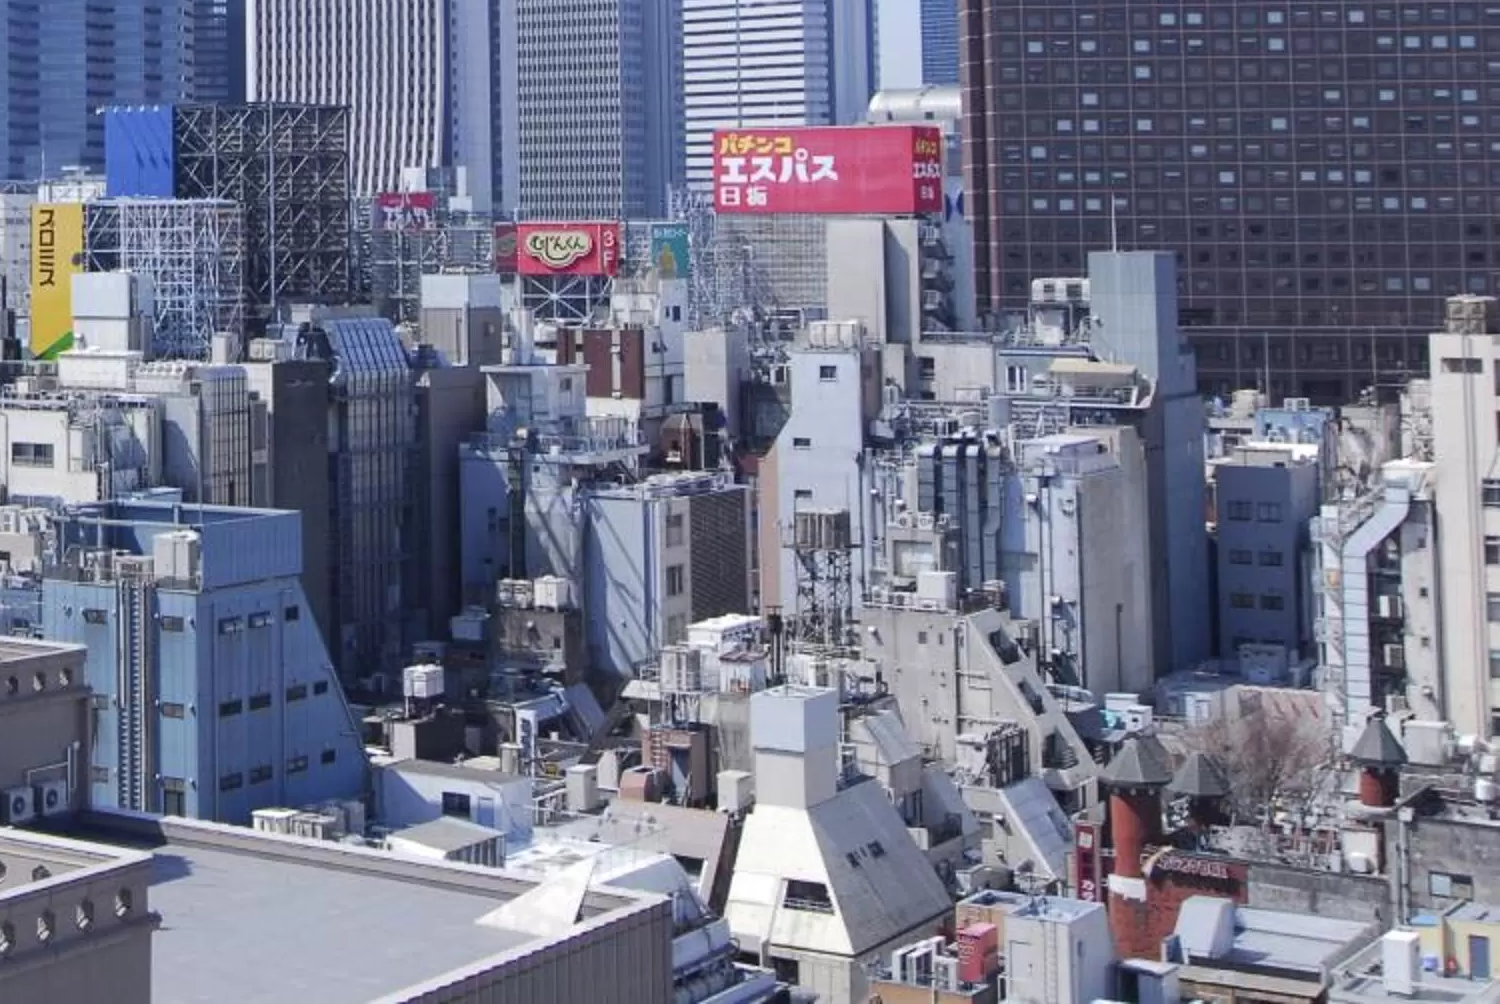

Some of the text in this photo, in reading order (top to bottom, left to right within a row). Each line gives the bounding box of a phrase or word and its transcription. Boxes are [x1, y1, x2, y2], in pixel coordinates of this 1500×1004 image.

[719, 133, 792, 155] パチンコ
[720, 147, 838, 183] エスパス
